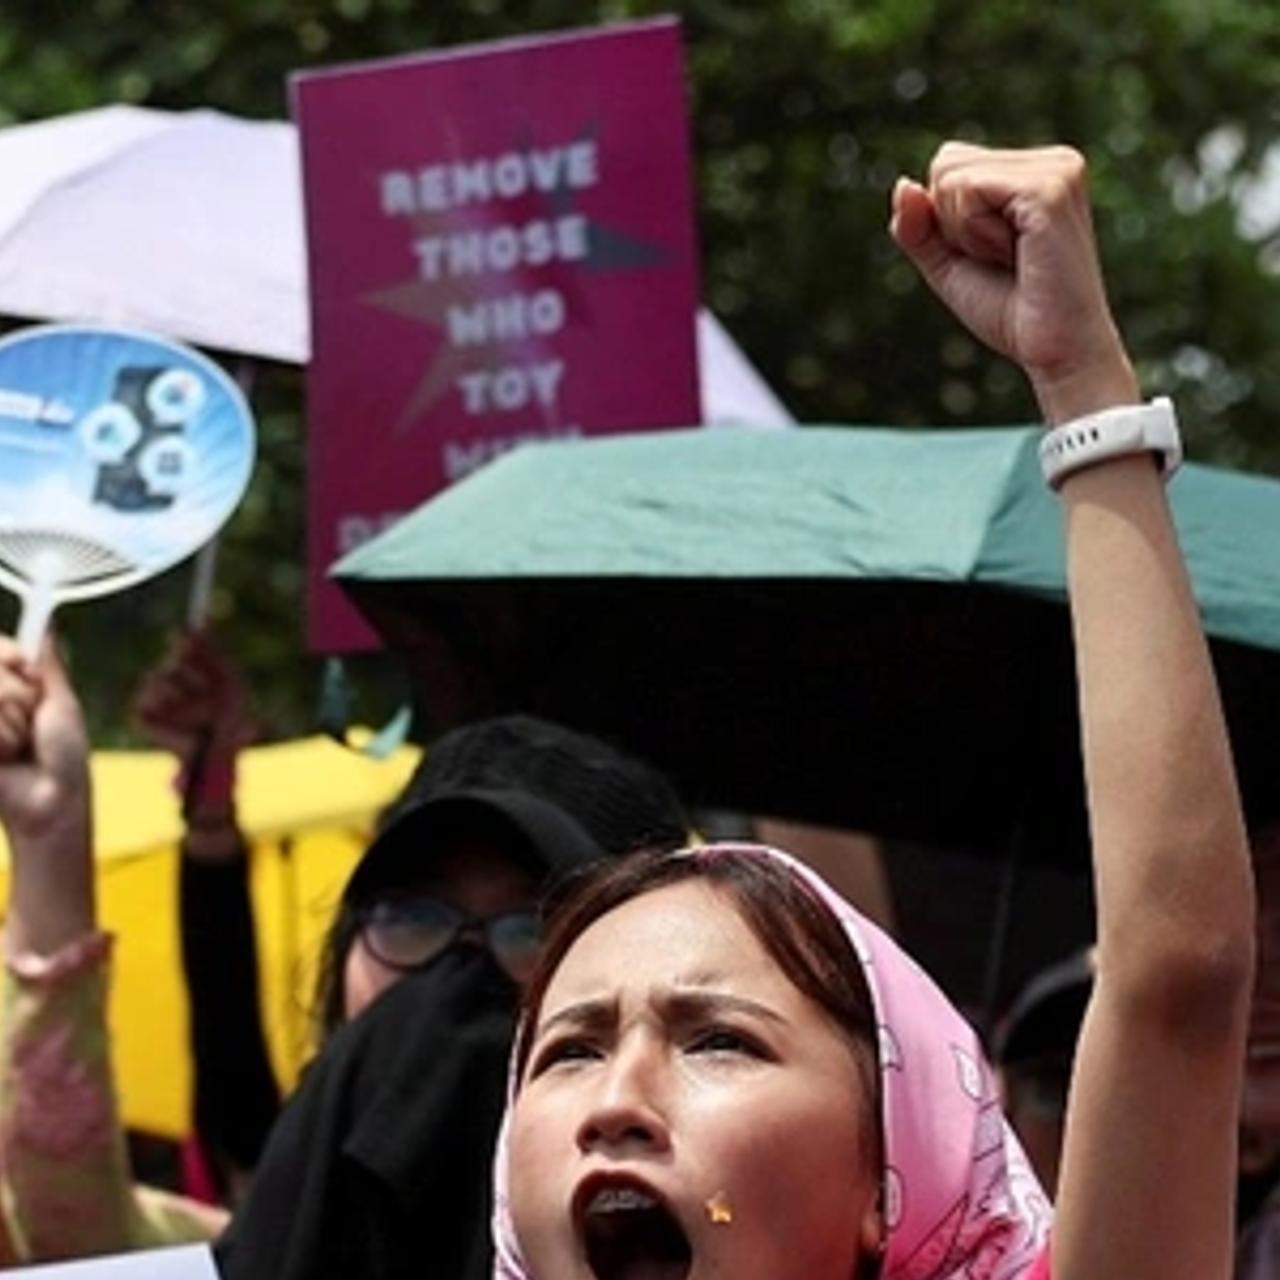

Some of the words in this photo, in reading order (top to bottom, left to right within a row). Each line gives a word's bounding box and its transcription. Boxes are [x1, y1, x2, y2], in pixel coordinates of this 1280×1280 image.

[380, 143, 598, 214] REMOVE
[414, 216, 590, 280] THOSE
[446, 289, 565, 347] WHO
[462, 363, 564, 413] TOY
